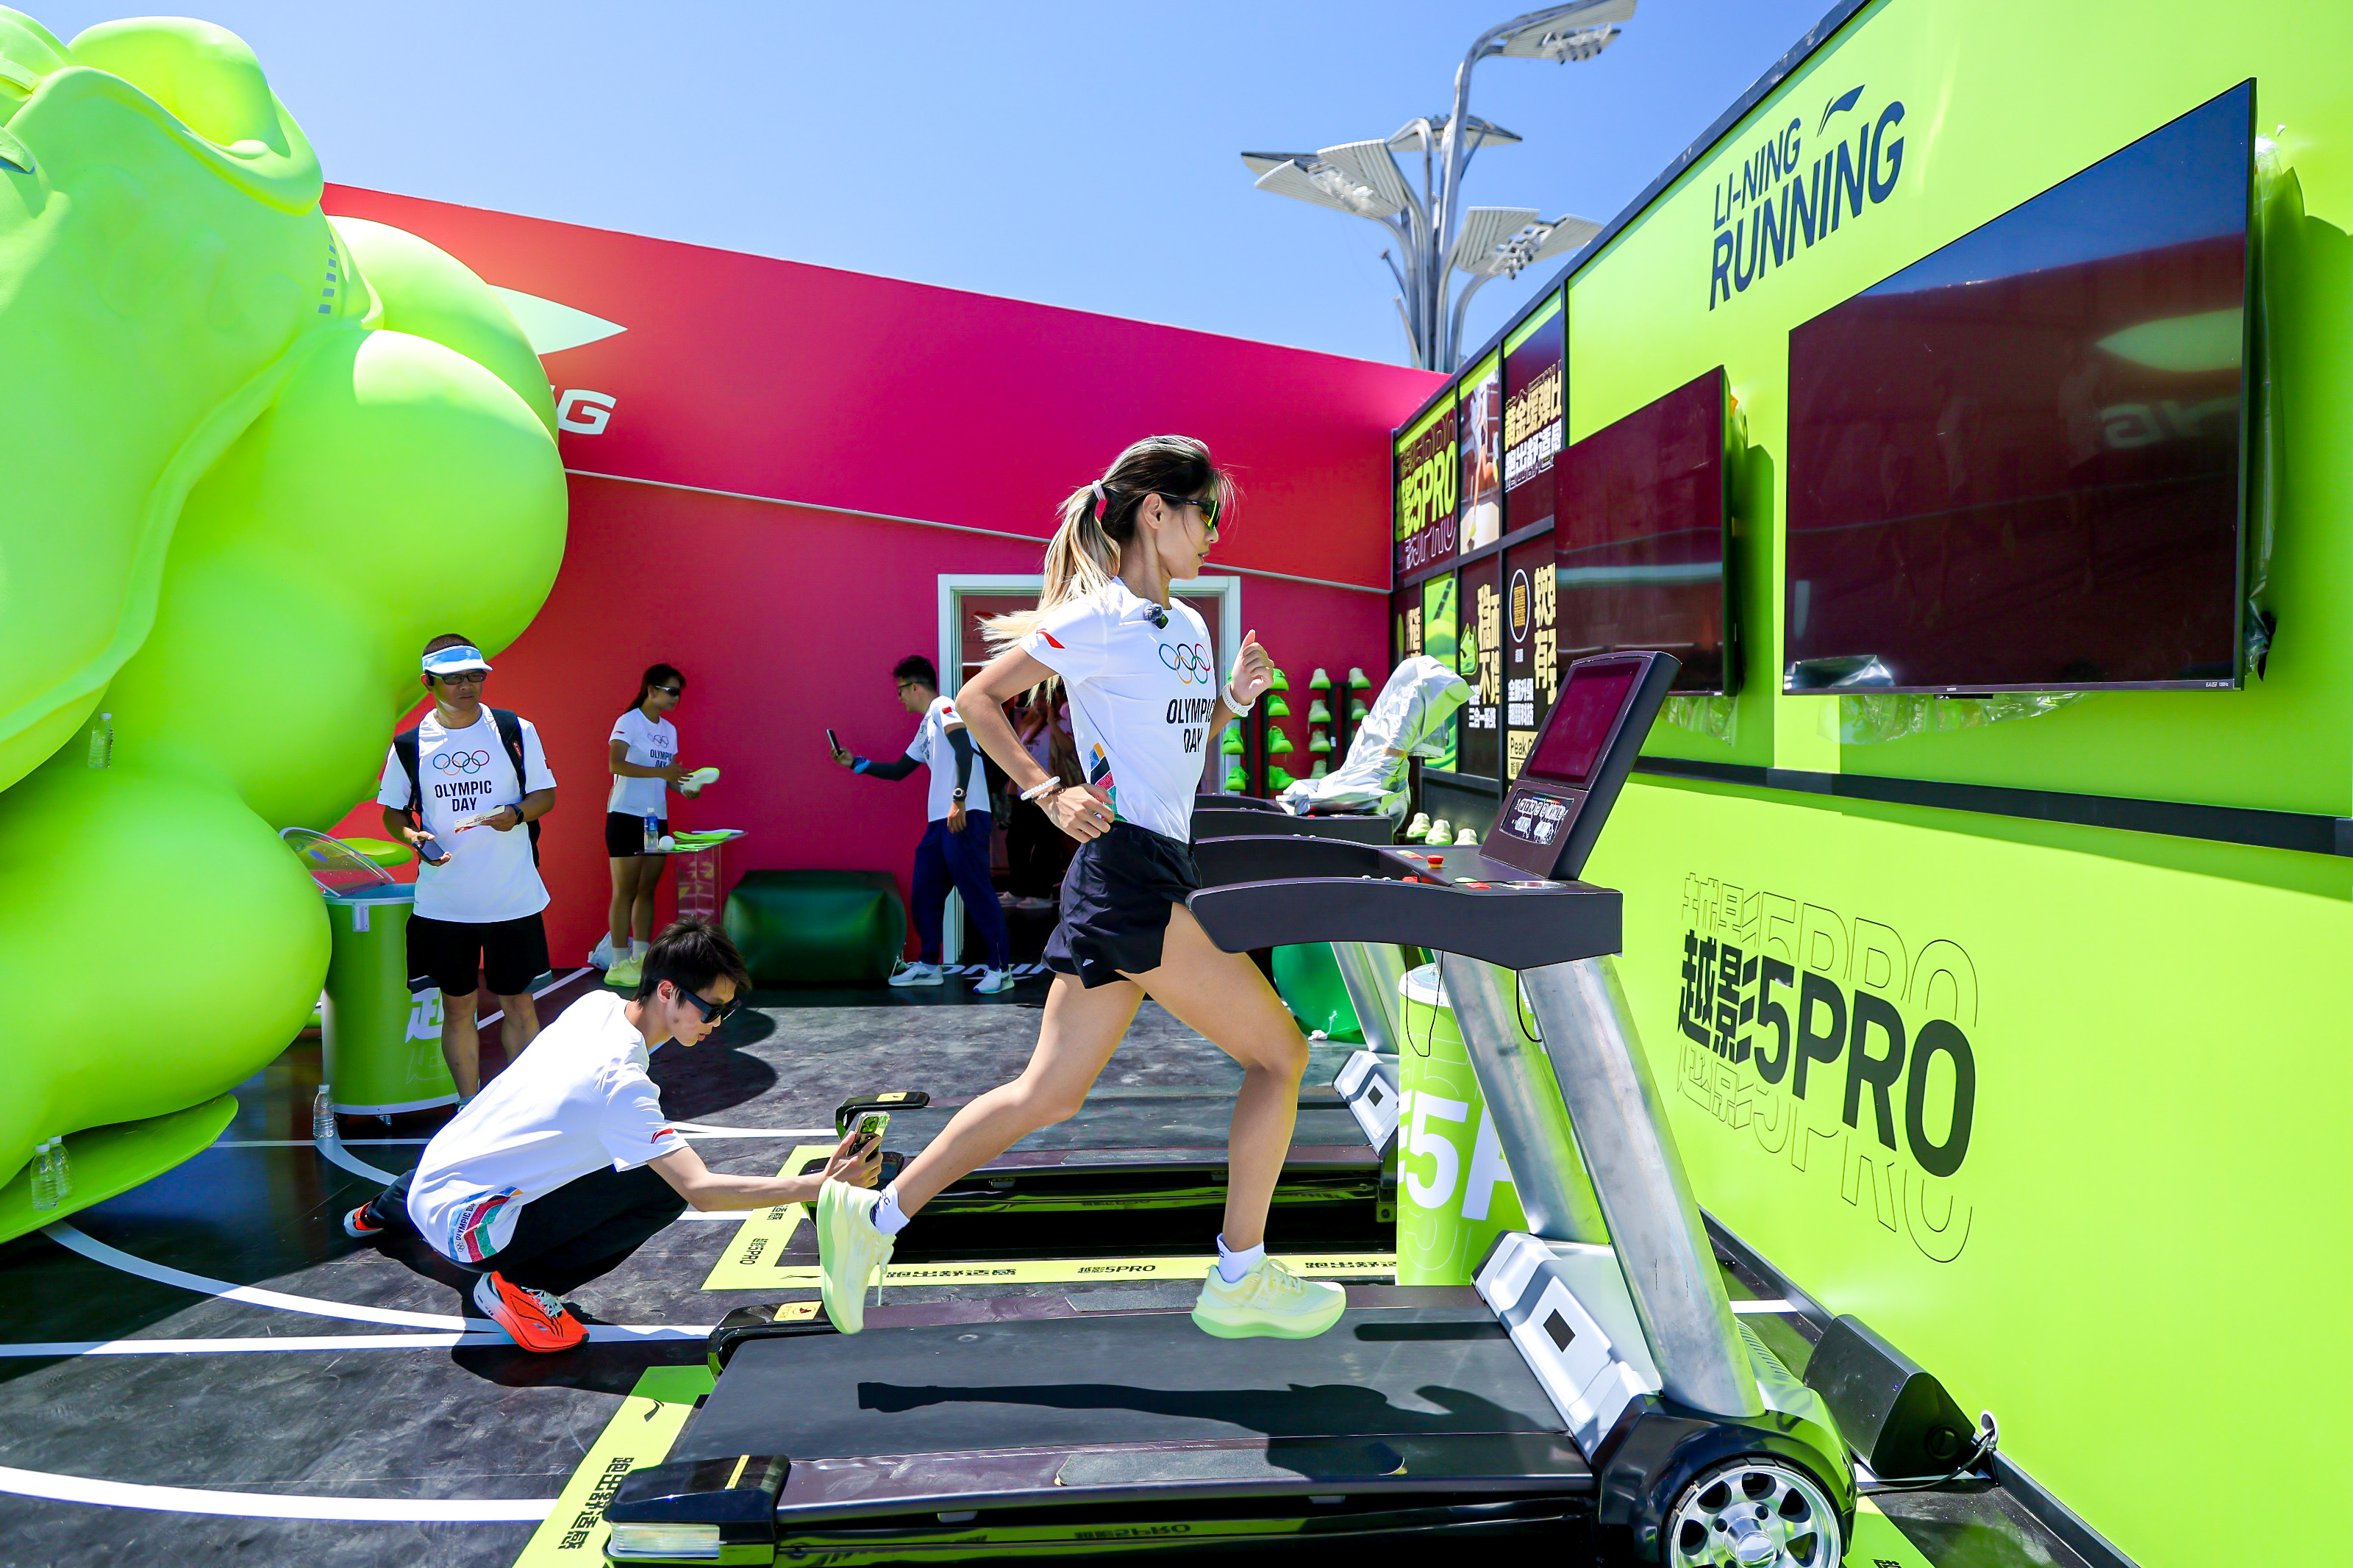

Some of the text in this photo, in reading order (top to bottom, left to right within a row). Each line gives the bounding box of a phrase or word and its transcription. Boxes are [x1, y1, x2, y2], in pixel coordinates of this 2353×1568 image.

[1714, 117, 1801, 229] LI-NING
[1710, 101, 1904, 312] RUNNING
[1183, 728, 1203, 753] DAY
[435, 780, 492, 798] OLYMPIC
[451, 797, 476, 812] DAY
[1677, 929, 1976, 1177] 越影5PRO
[455, 1211, 471, 1241] OLYMPIC
[1077, 1264, 1156, 1274] 越影5PRO
[557, 1457, 635, 1550] 跑出舒适感
